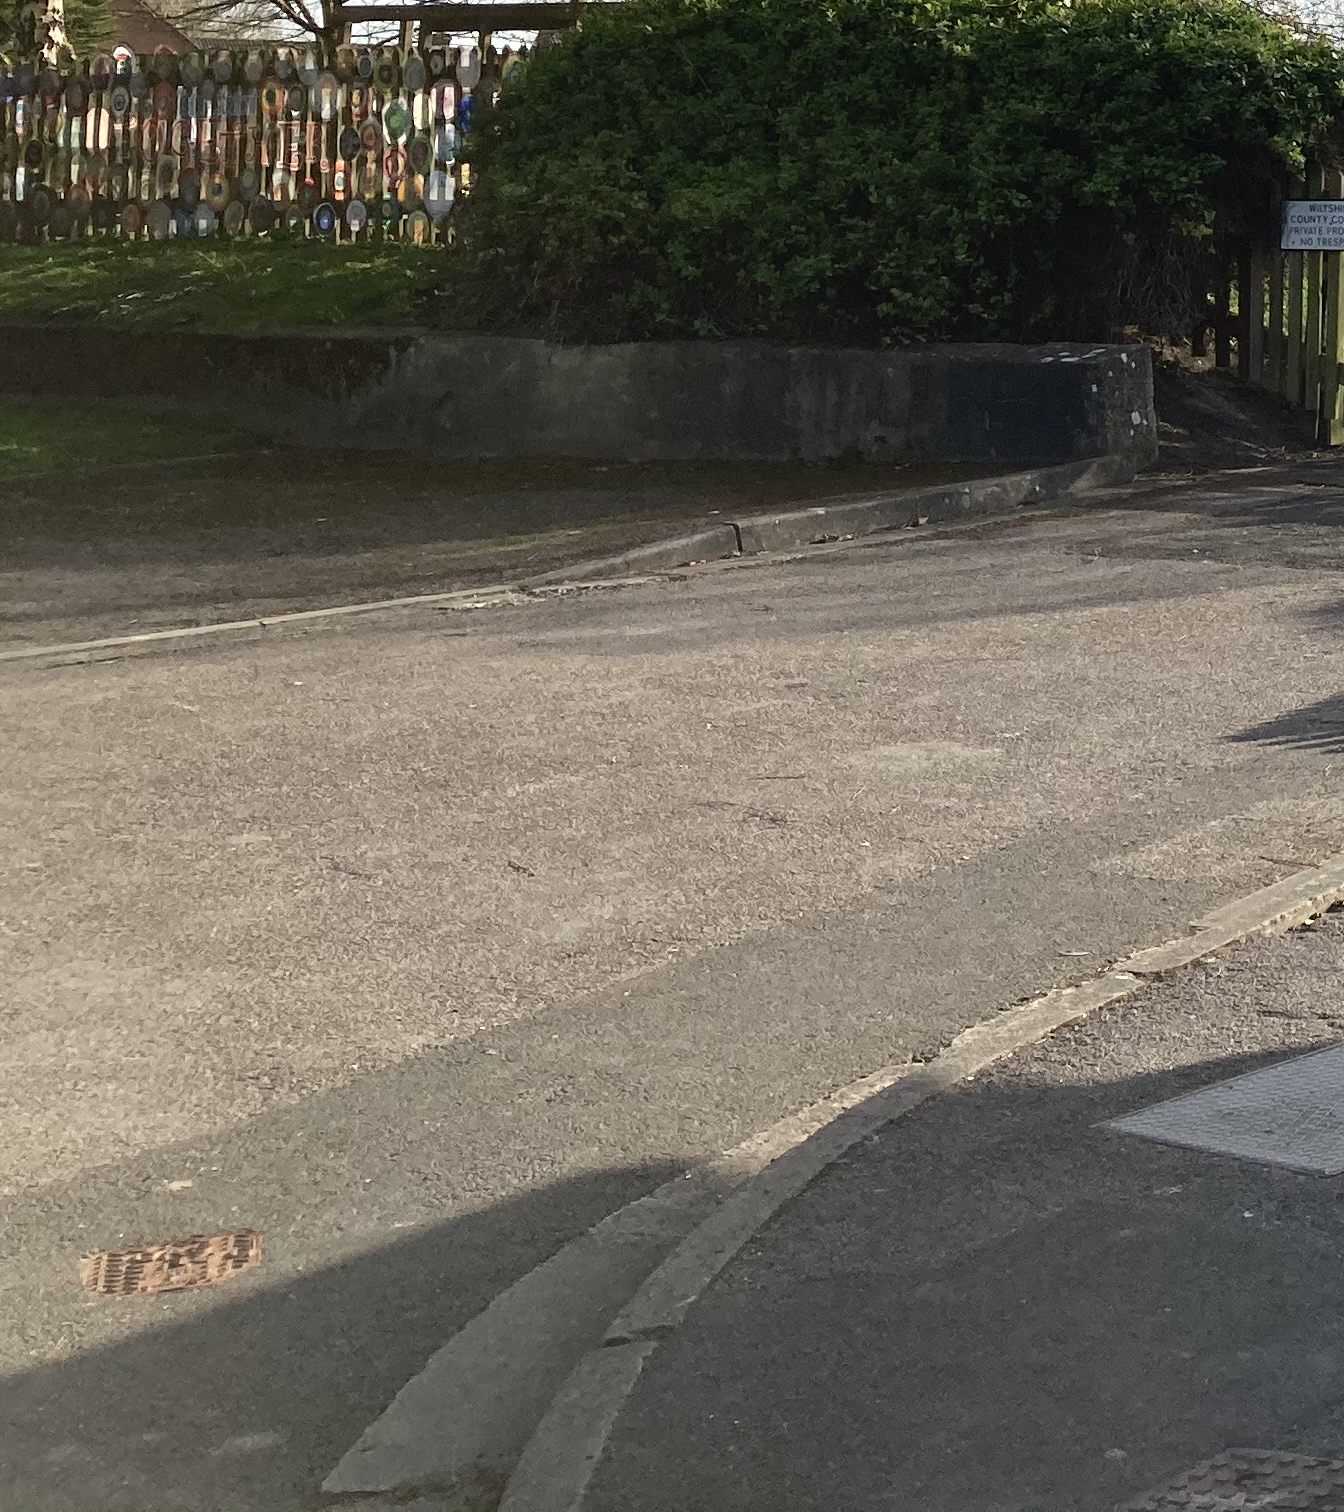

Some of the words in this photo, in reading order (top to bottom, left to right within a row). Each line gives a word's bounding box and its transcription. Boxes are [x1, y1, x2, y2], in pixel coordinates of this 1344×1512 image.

[1290, 215, 1328, 224] COUNTY
[1288, 226, 1323, 235] PRIVATE
[1300, 238, 1314, 246] NO
